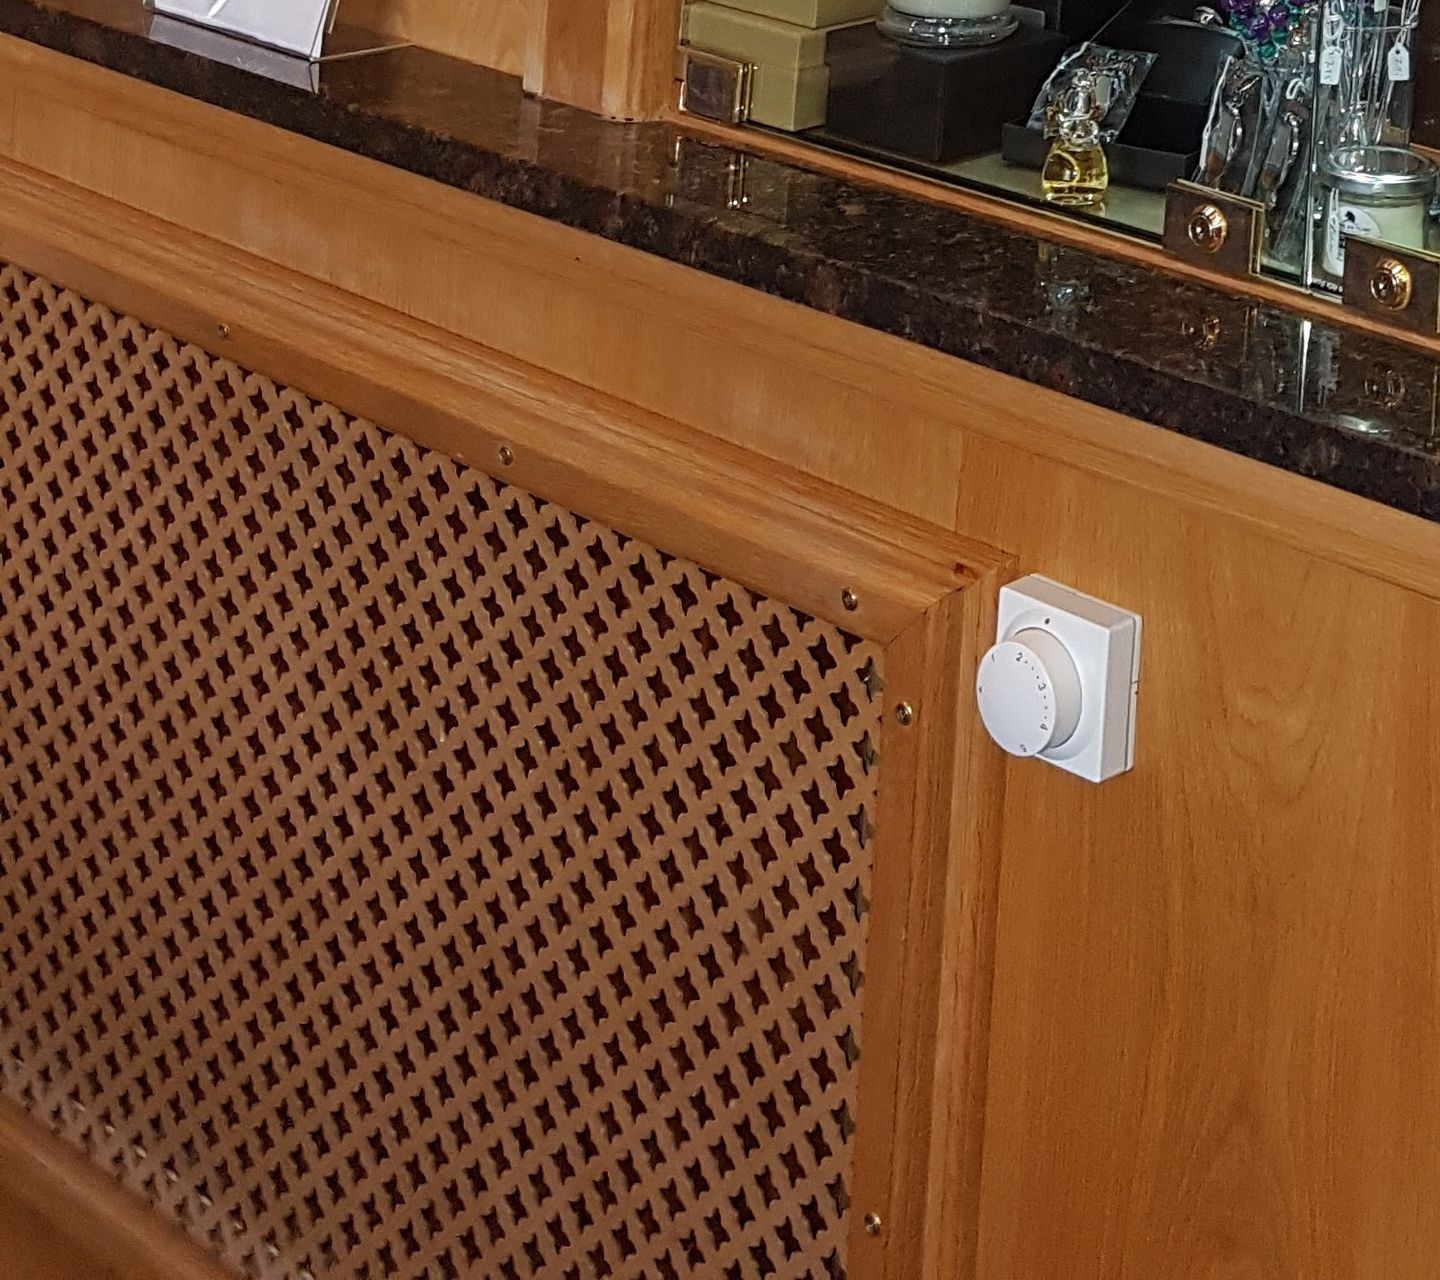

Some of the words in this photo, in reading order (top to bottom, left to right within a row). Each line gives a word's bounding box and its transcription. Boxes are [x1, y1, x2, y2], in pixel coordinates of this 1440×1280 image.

[1015, 652, 1023, 662] 2
[1038, 683, 1046, 691] 3
[1040, 723, 1048, 731] 4
